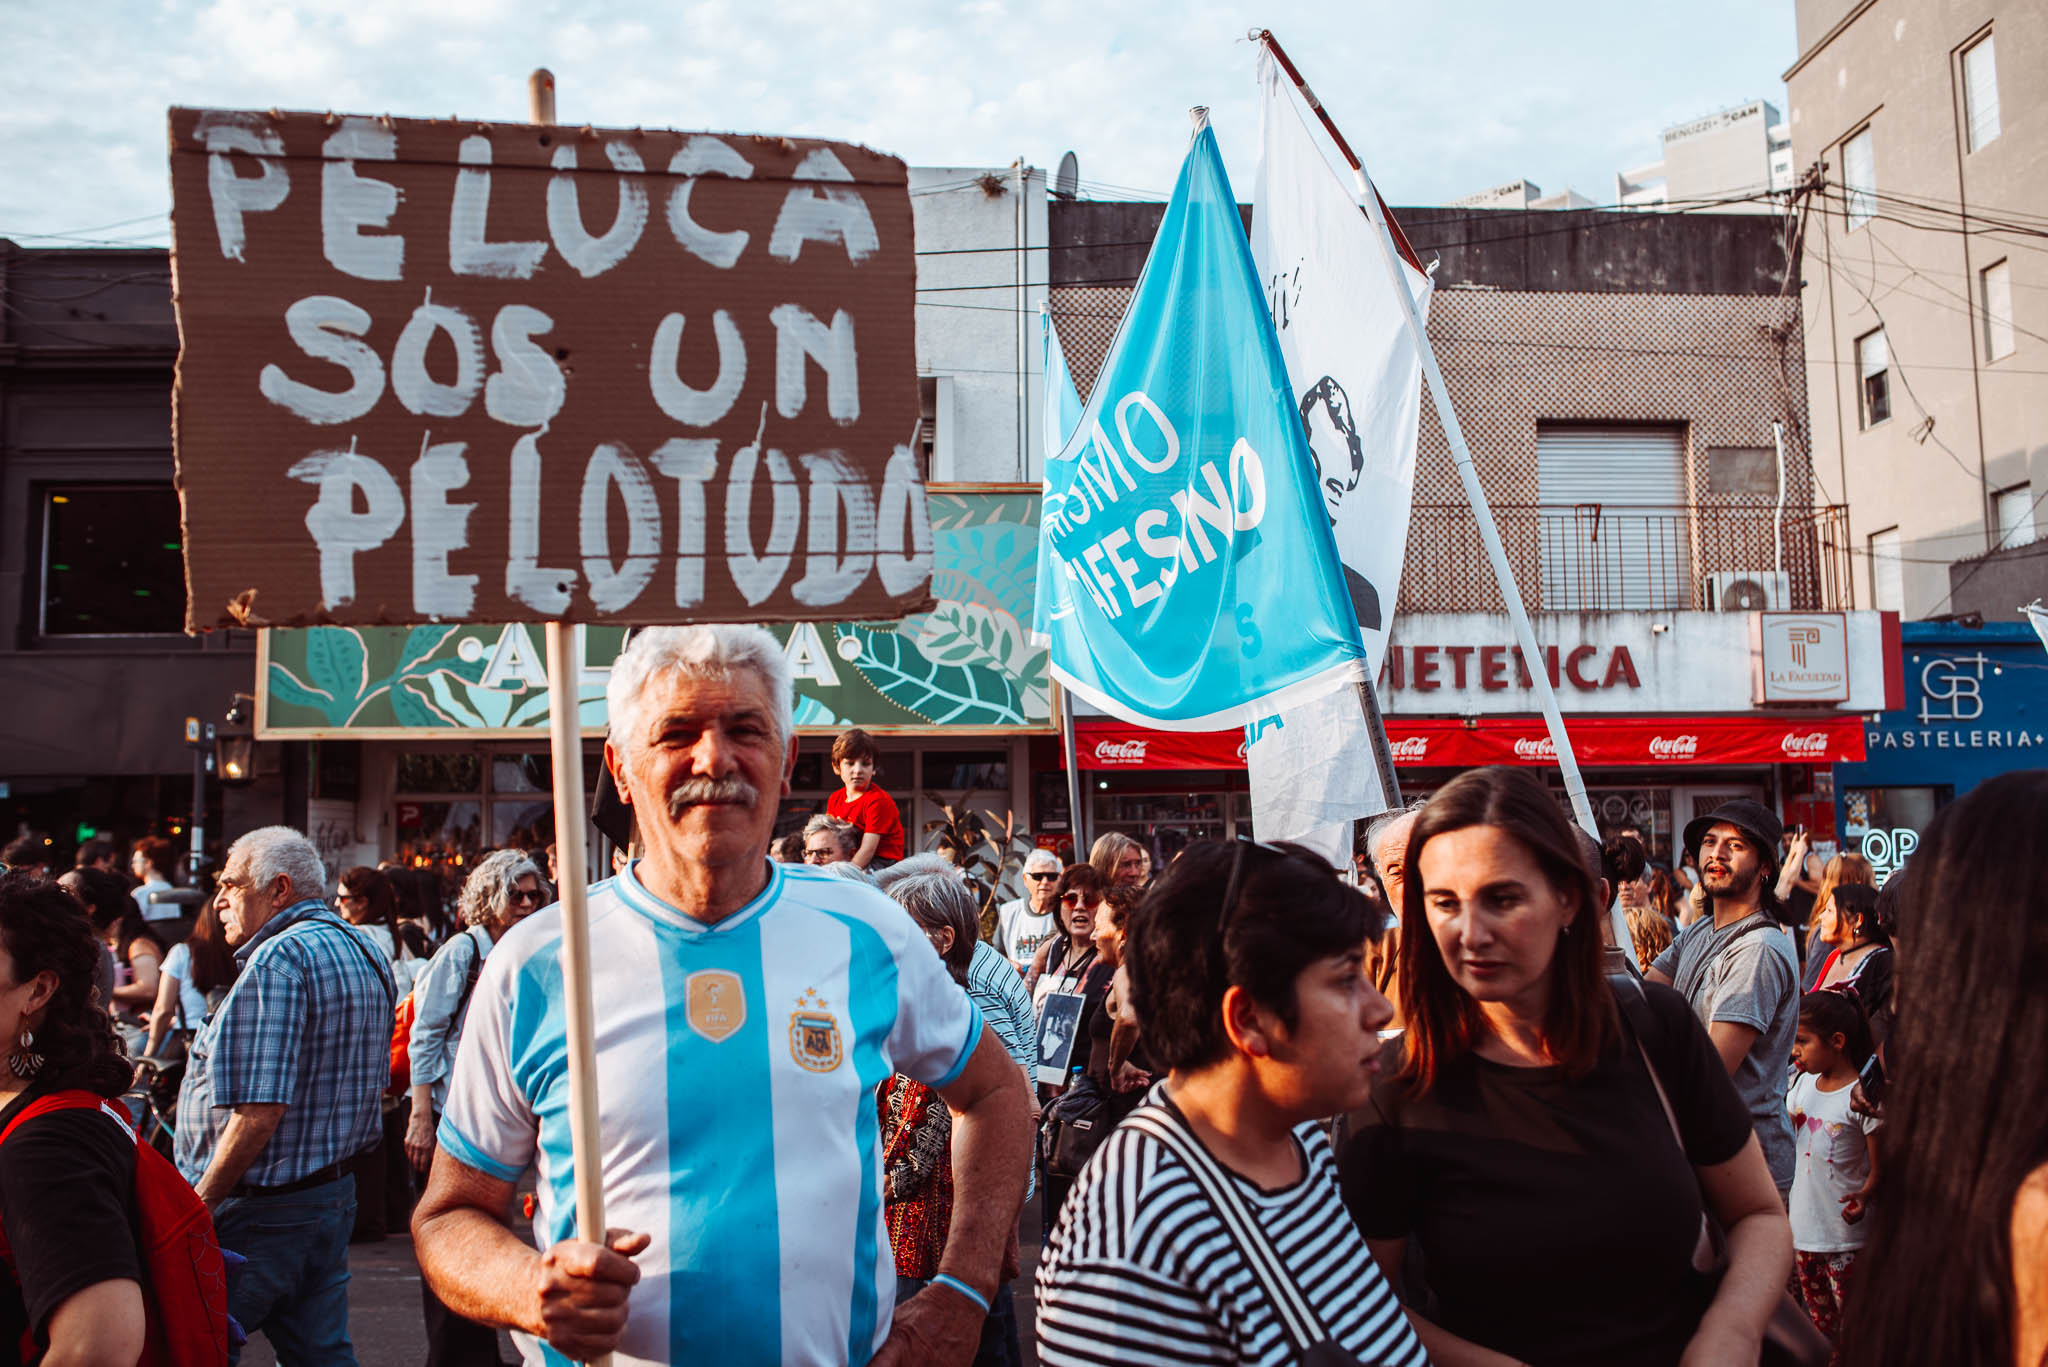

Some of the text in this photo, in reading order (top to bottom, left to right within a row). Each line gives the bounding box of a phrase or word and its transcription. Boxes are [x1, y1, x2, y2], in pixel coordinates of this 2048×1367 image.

[194, 111, 880, 281] PELUCA
[259, 289, 860, 427] SOS UN
[287, 422, 934, 617] PELOTUDO
[1377, 645, 1642, 688] IETETICA
[1770, 671, 1785, 681] LA
